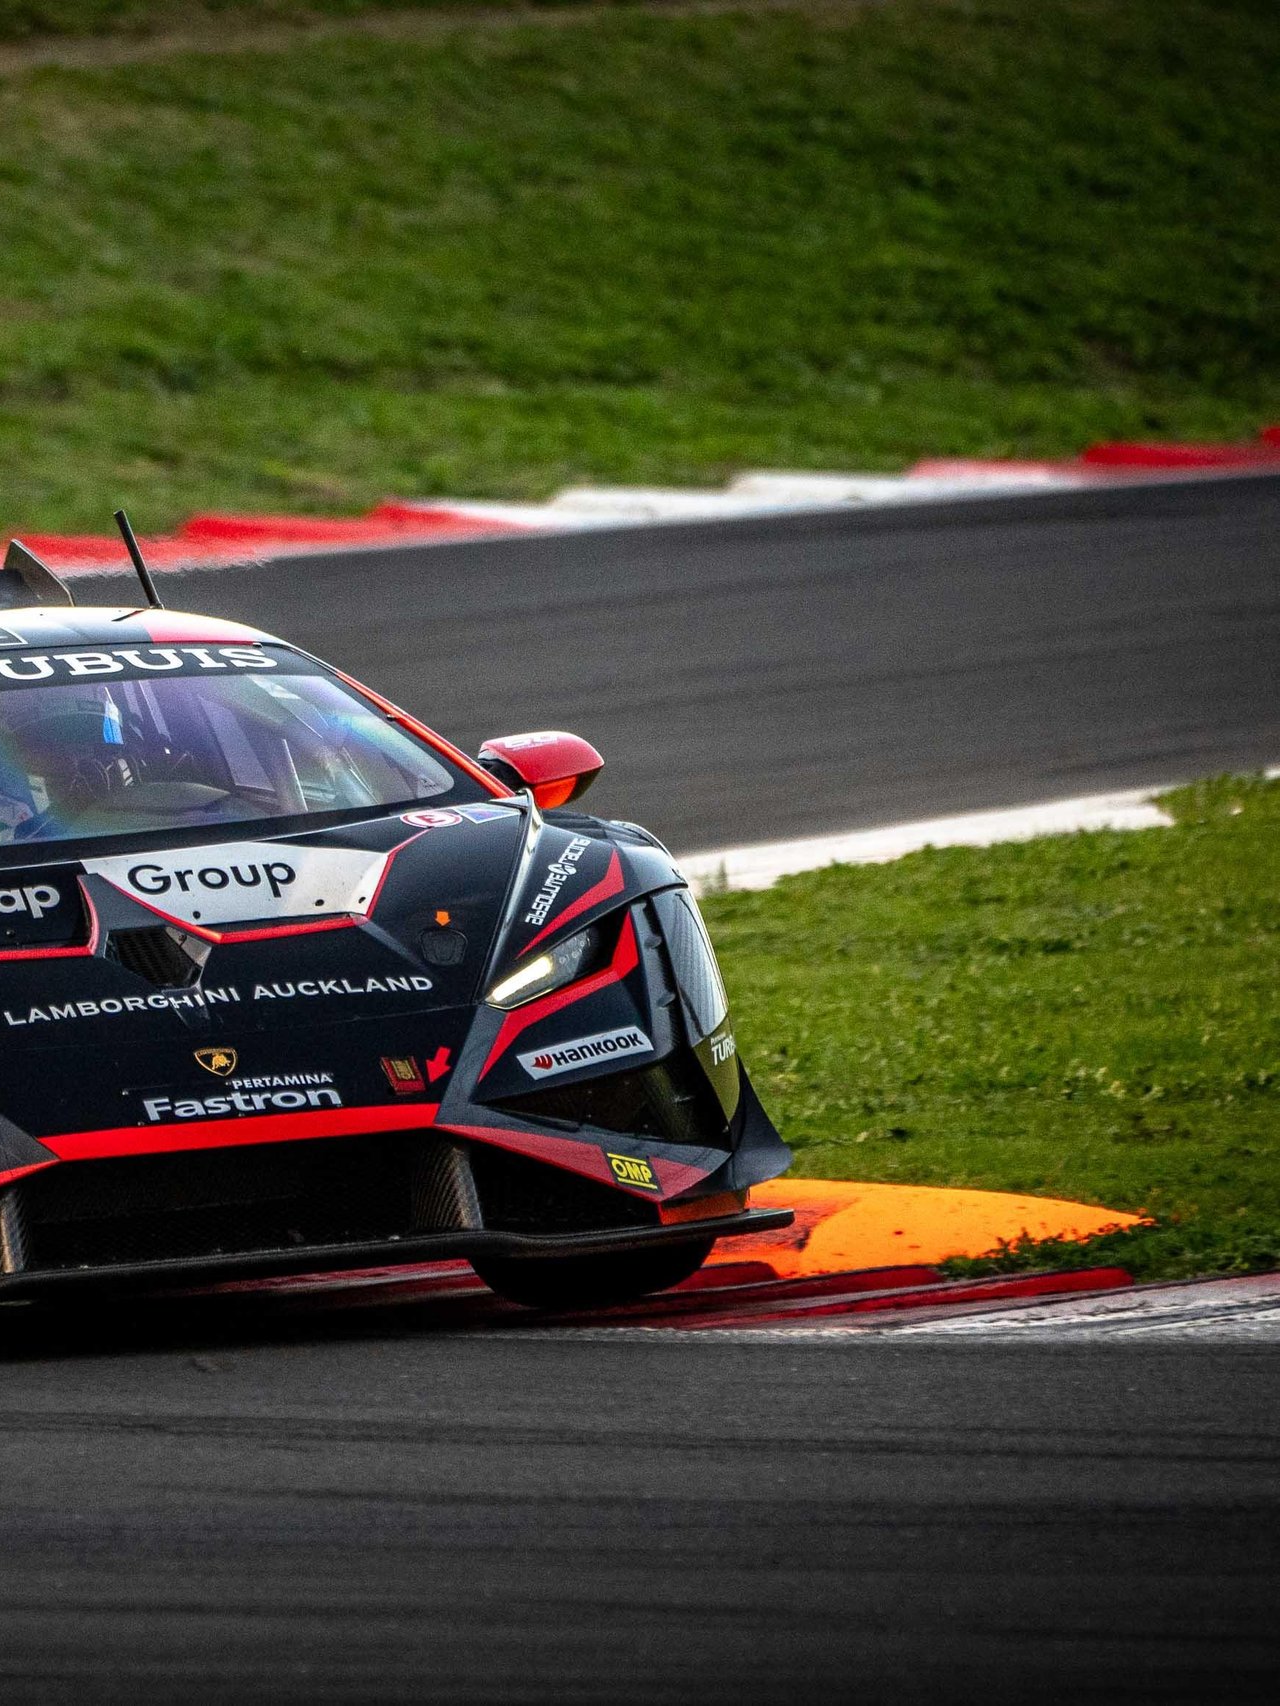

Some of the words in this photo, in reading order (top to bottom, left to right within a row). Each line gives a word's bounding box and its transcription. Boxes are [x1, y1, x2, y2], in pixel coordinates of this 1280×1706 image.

[128, 859, 297, 898] Group
[4, 987, 241, 1027] LAMBORGHINI
[253, 976, 433, 1000] AUCKLAND
[232, 1073, 333, 1090] PERTAMINA
[143, 1088, 342, 1122] Fastron
[611, 1158, 653, 1183] OMP
